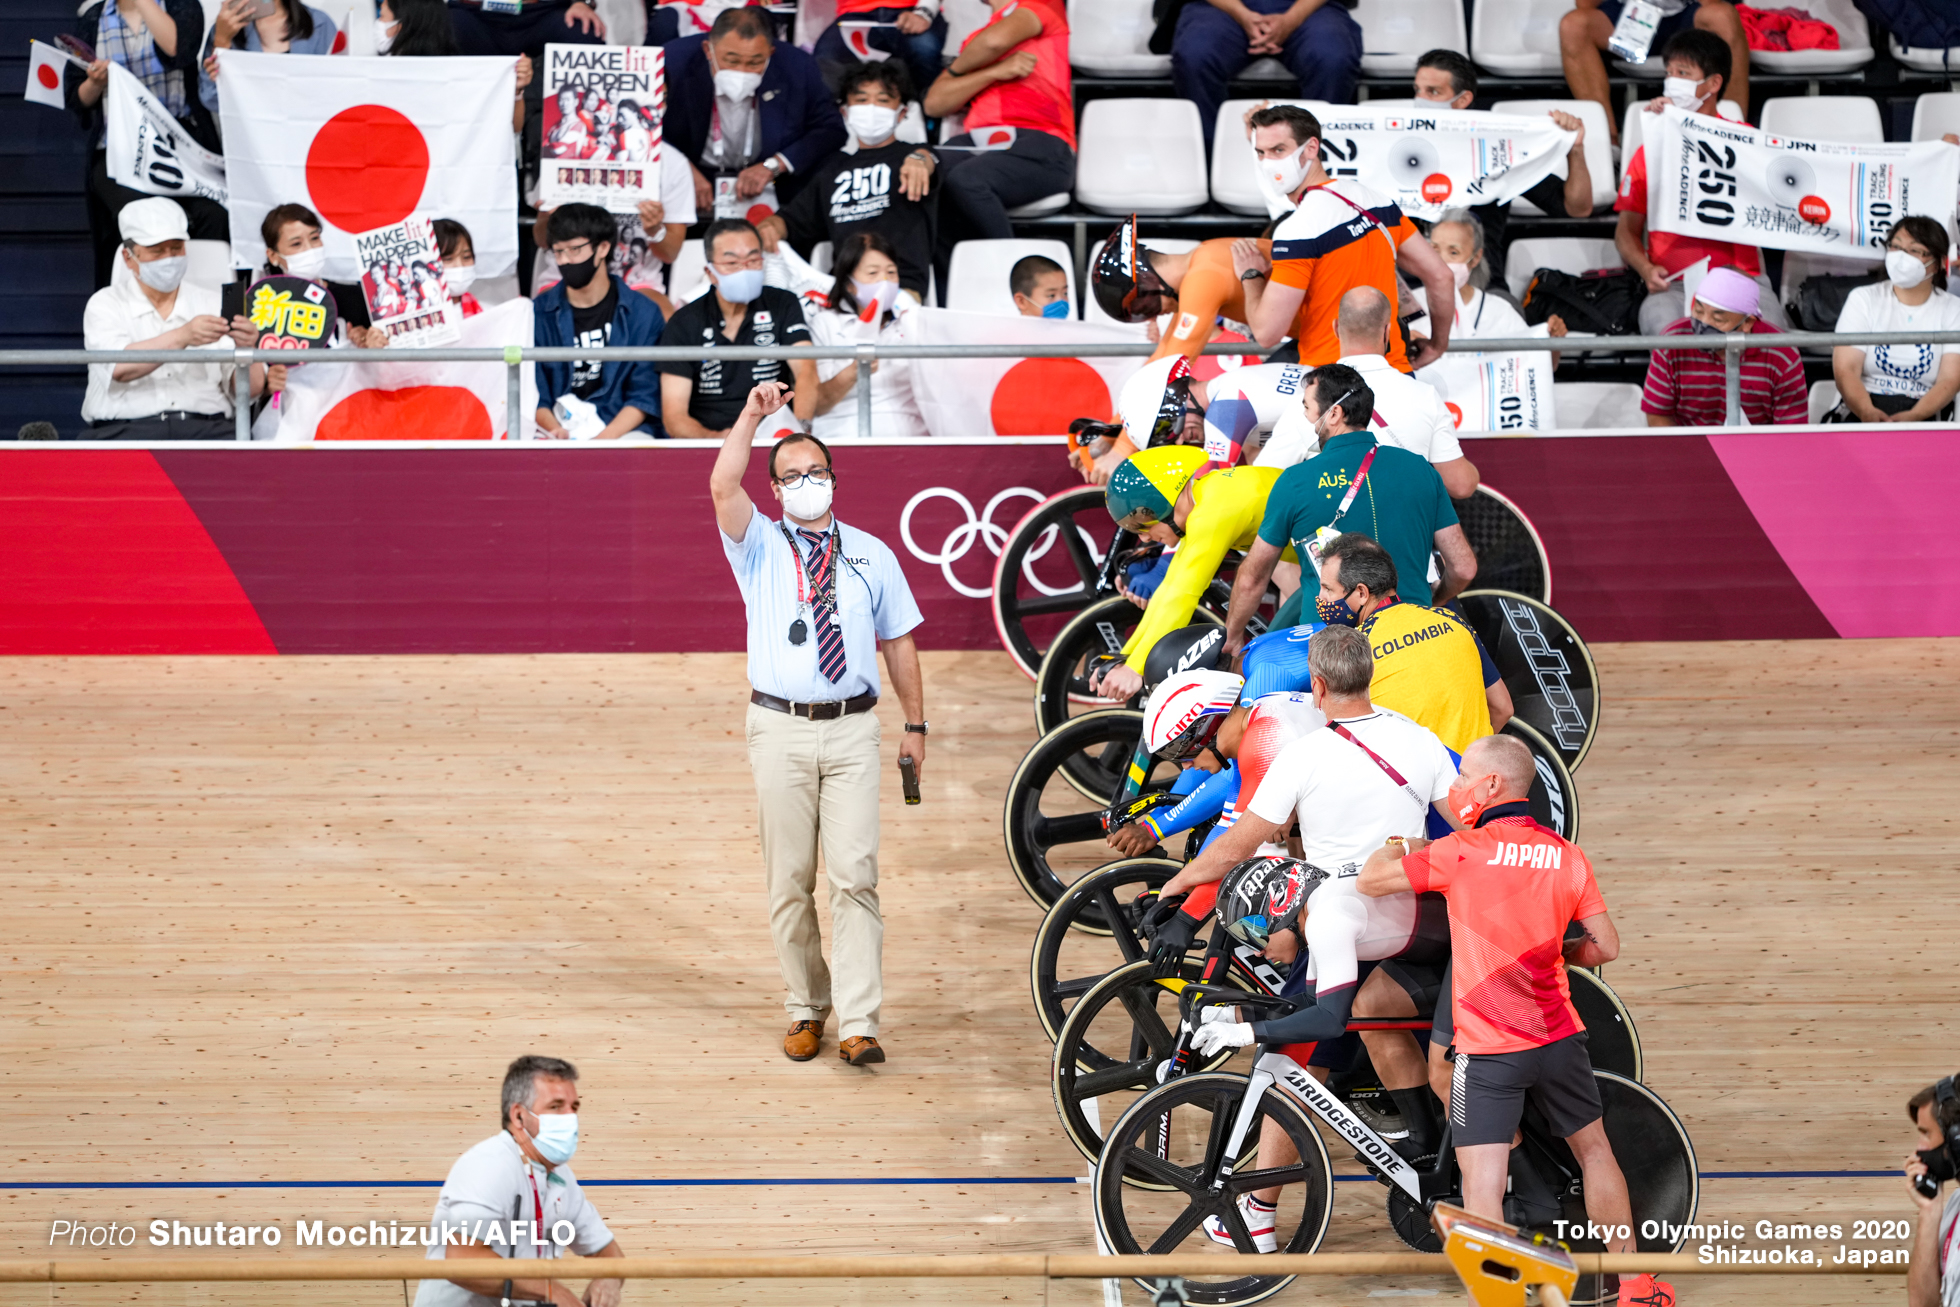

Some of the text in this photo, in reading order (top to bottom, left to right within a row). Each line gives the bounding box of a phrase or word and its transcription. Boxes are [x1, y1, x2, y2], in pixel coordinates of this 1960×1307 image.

[553, 51, 622, 71] MAKE
[552, 71, 649, 92] HAPPEN
[1407, 119, 1436, 130] JPN
[1787, 141, 1817, 152] JPN
[830, 163, 891, 204] 250
[1696, 140, 1737, 226] 250
[1803, 205, 1827, 217] KEIRIN
[357, 227, 406, 253] MAKE
[361, 238, 428, 269] HAPPEN
[249, 283, 327, 340] 新田
[1174, 474, 1189, 491] KASK
[850, 557, 870, 566] UCI
[1167, 628, 1222, 678] LAZER
[1373, 622, 1454, 660] COLOMBIA
[1165, 702, 1205, 741] GIRO
[1486, 841, 1562, 870] JAPAN
[1236, 856, 1284, 916] Japan
[1284, 1070, 1404, 1175] BRIDGESTONE
